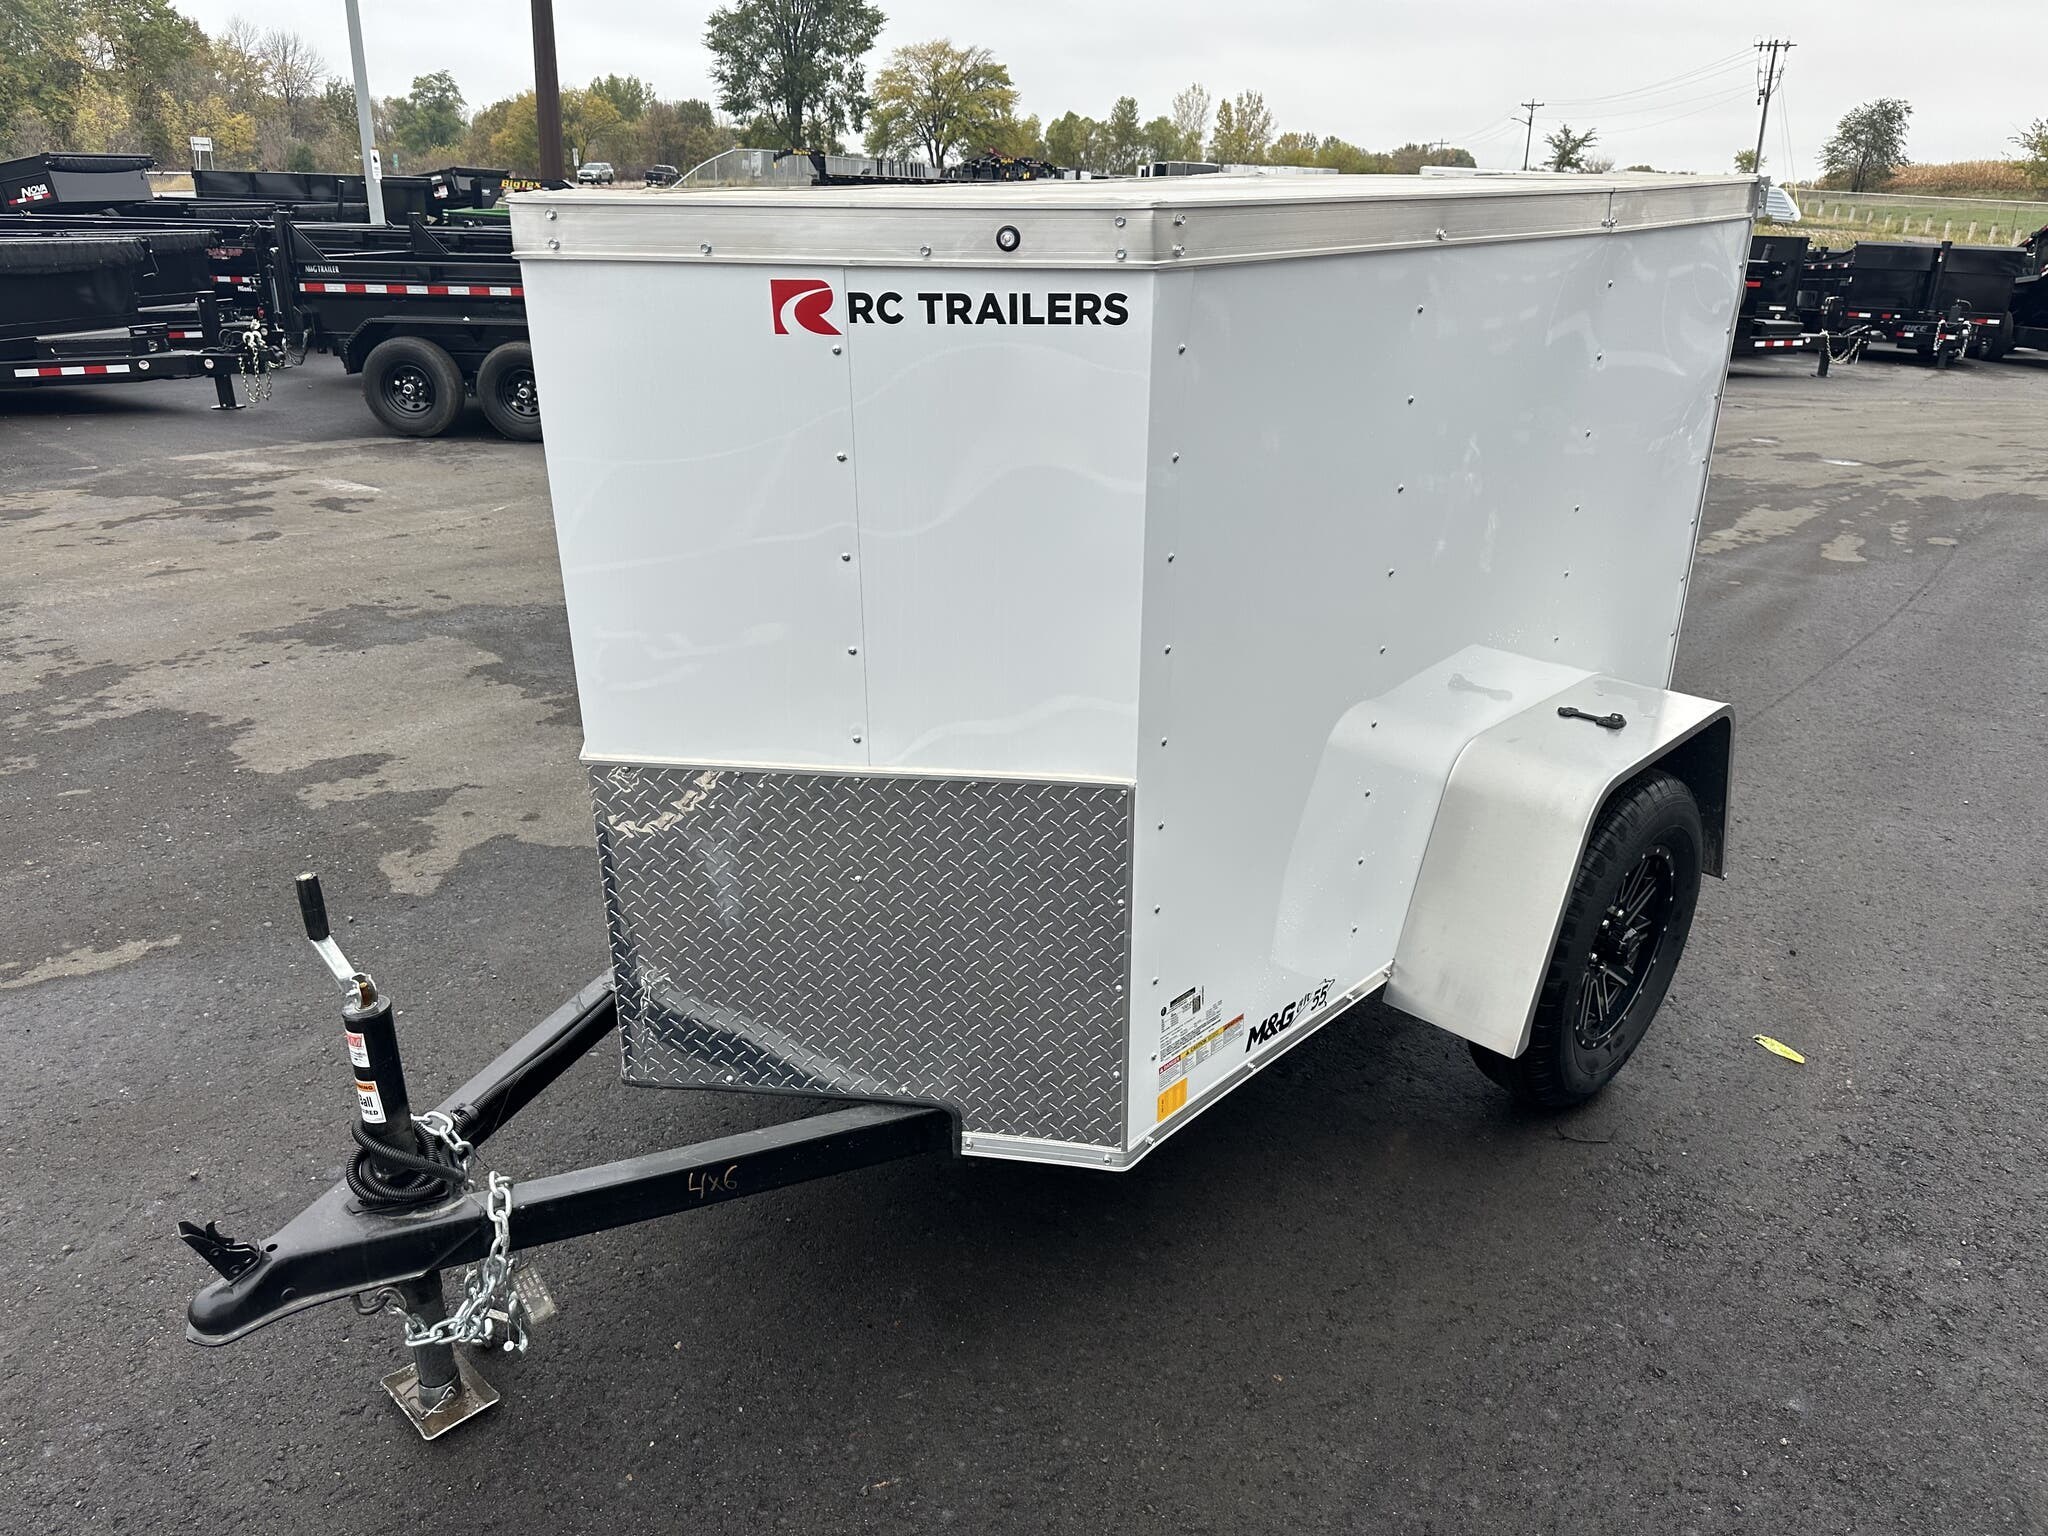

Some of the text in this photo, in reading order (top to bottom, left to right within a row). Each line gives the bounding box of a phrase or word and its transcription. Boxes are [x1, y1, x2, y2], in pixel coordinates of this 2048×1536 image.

[21, 184, 48, 198] NOVA
[847, 291, 1130, 326] RC TRAILERS
[1902, 324, 1928, 333] RICE
[1245, 1001, 1296, 1053] M&G
